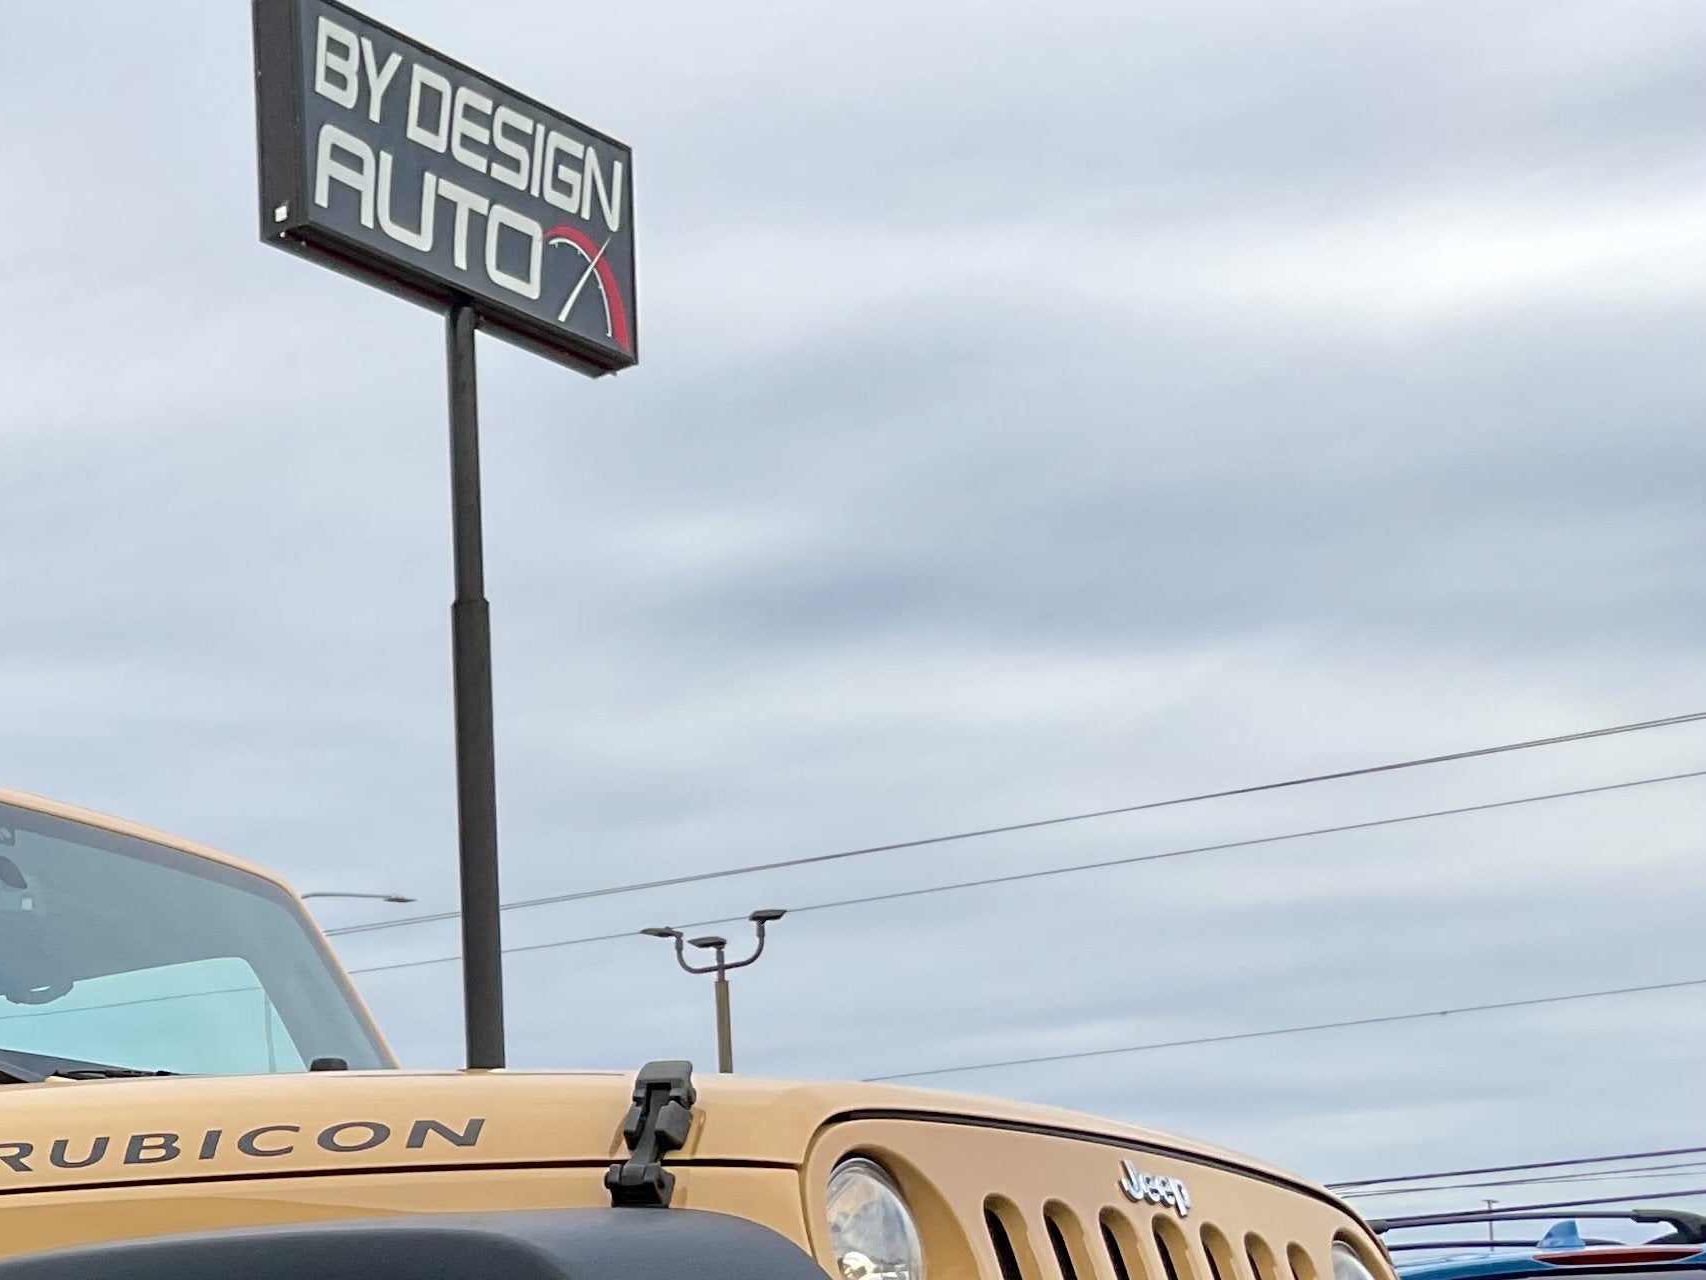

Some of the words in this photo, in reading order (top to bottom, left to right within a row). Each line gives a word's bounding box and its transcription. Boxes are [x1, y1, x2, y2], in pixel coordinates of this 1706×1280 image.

[315, 15, 402, 123] BY
[406, 63, 622, 232] DESIGN
[314, 124, 543, 300] AUTO
[1118, 1158, 1191, 1218] Jeep
